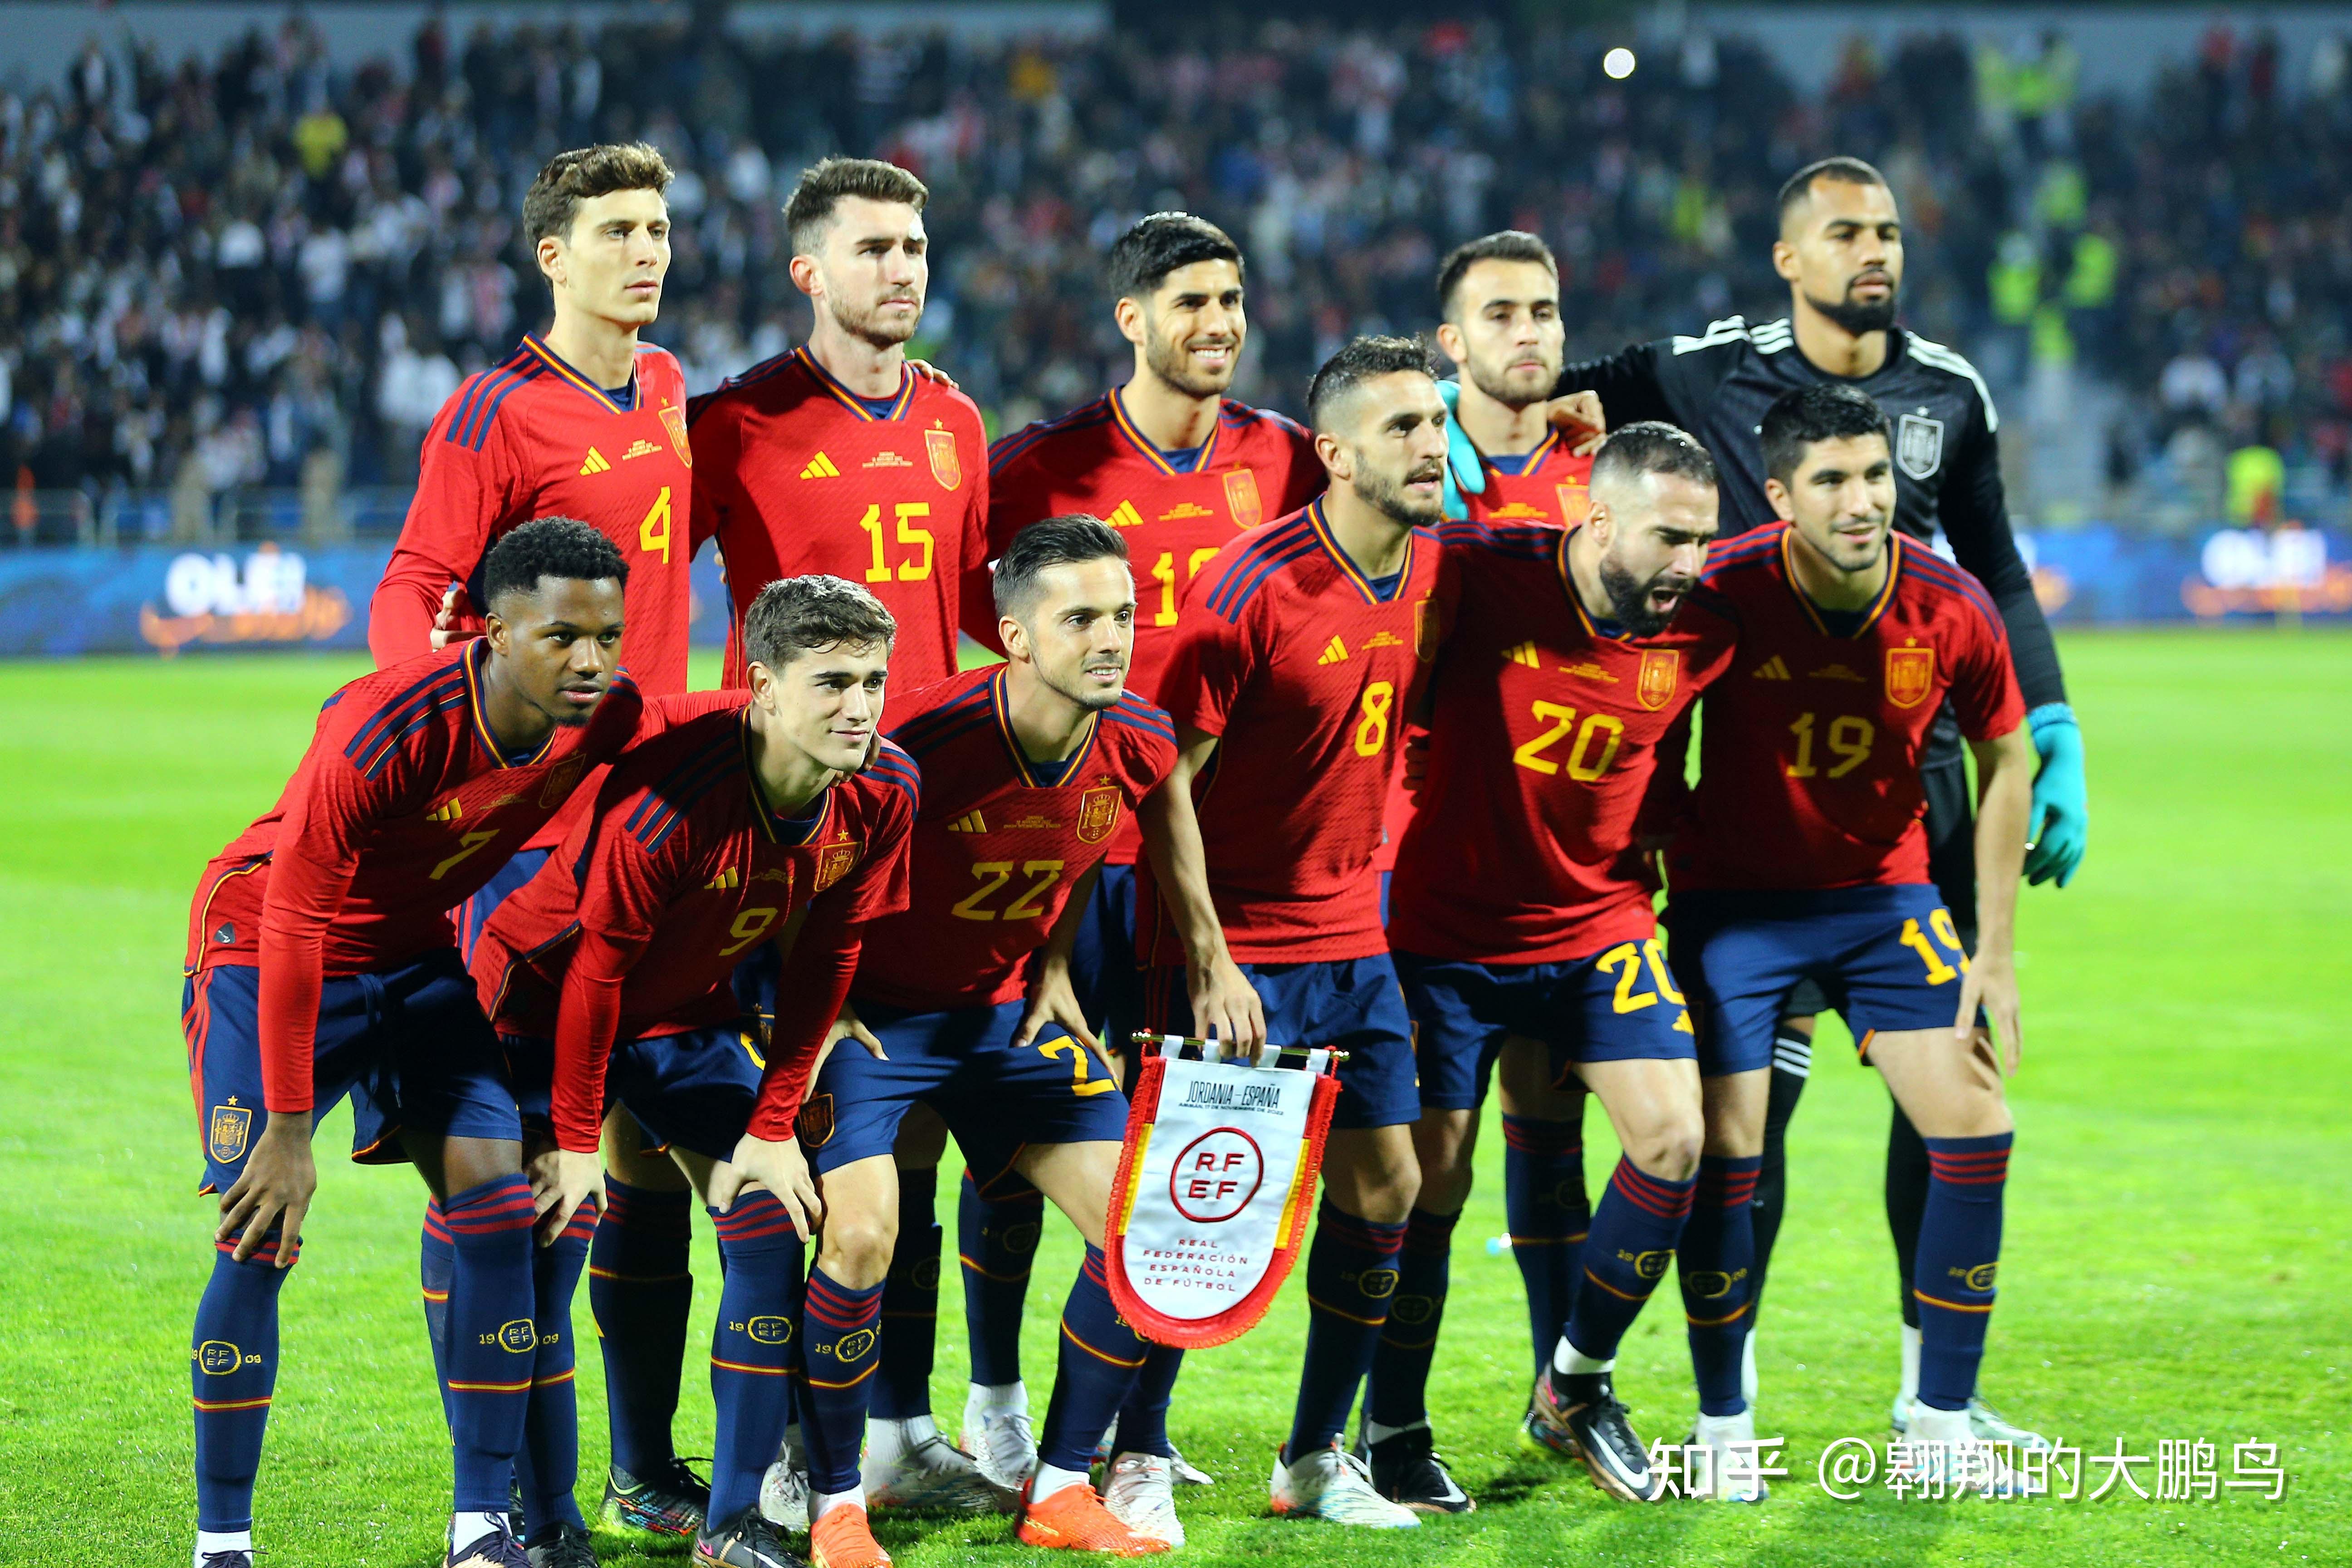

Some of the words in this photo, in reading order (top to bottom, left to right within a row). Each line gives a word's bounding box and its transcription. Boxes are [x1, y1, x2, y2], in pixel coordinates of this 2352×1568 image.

[639, 486, 671, 564] 4
[859, 502, 935, 583] 15
[1354, 681, 1394, 757] 8
[1513, 700, 1624, 782] 20
[1787, 712, 1874, 778] 19
[429, 828, 500, 880] 7
[952, 860, 1064, 921] 22
[718, 906, 779, 957] 9
[1037, 1035, 1122, 1097] 2
[1186, 1081, 1234, 1105] JORDANIA
[1241, 1083, 1281, 1108] ESPAÑA
[1143, 1250, 1248, 1264] FEDERACIÓN
[1178, 1239, 1218, 1248] REAL
[1149, 1264, 1235, 1277] ESPAÑOLA
[1173, 1278, 1235, 1292] FÚTBOL
[479, 1333, 495, 1345] 19
